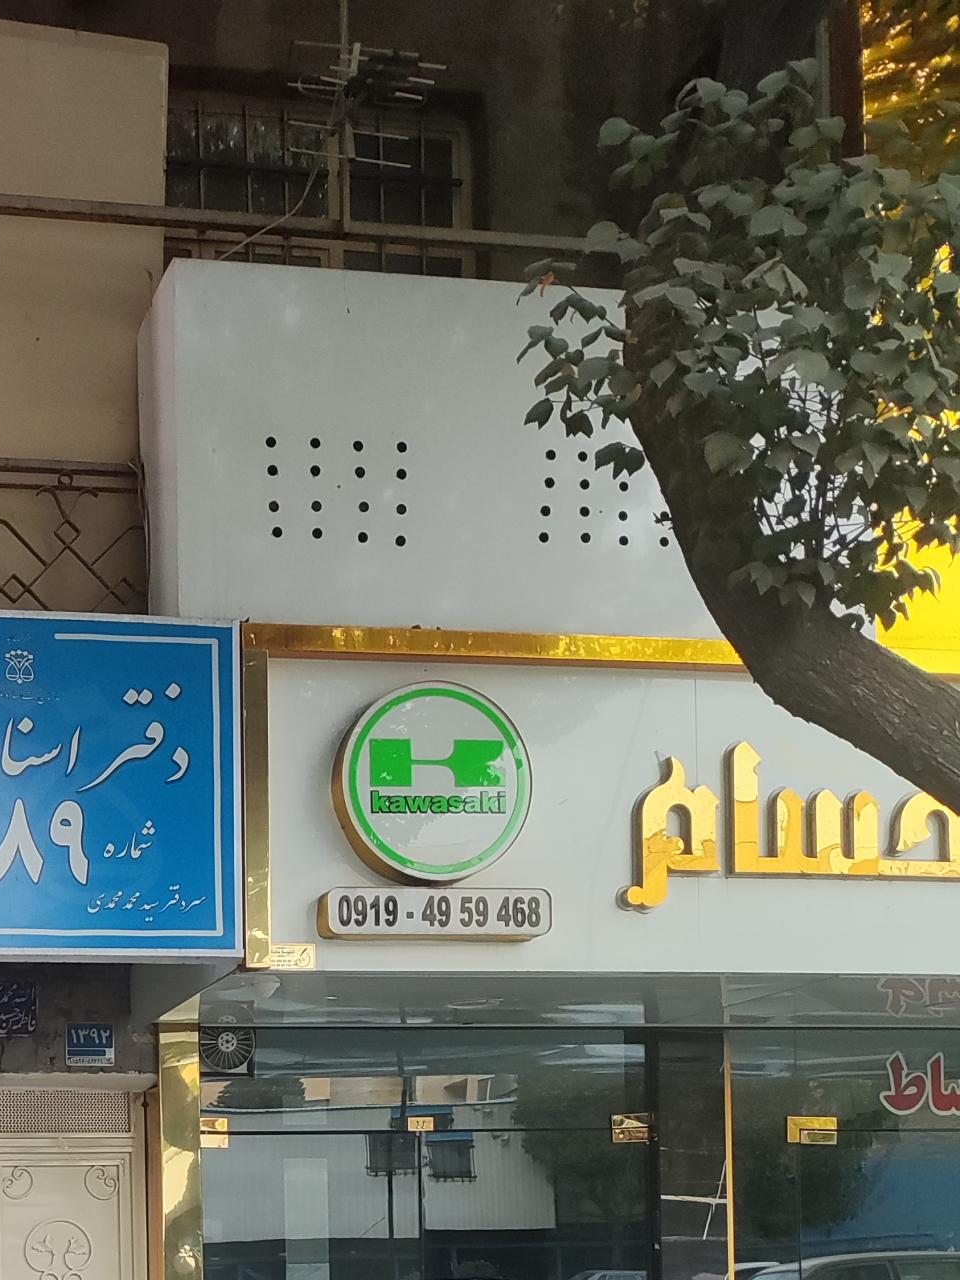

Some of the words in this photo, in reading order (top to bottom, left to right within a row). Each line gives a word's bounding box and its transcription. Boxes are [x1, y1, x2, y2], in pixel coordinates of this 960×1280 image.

[78, 681, 190, 793] دفتر
[370, 790, 506, 814] kawasaki
[103, 819, 156, 859] شماره
[87, 891, 123, 913] محمدی
[121, 891, 141, 910] محمد
[139, 900, 159, 922] سید
[338, 895, 399, 927] 0919
[421, 895, 451, 928] 49
[459, 896, 489, 928] 59
[496, 896, 542, 928] 468
